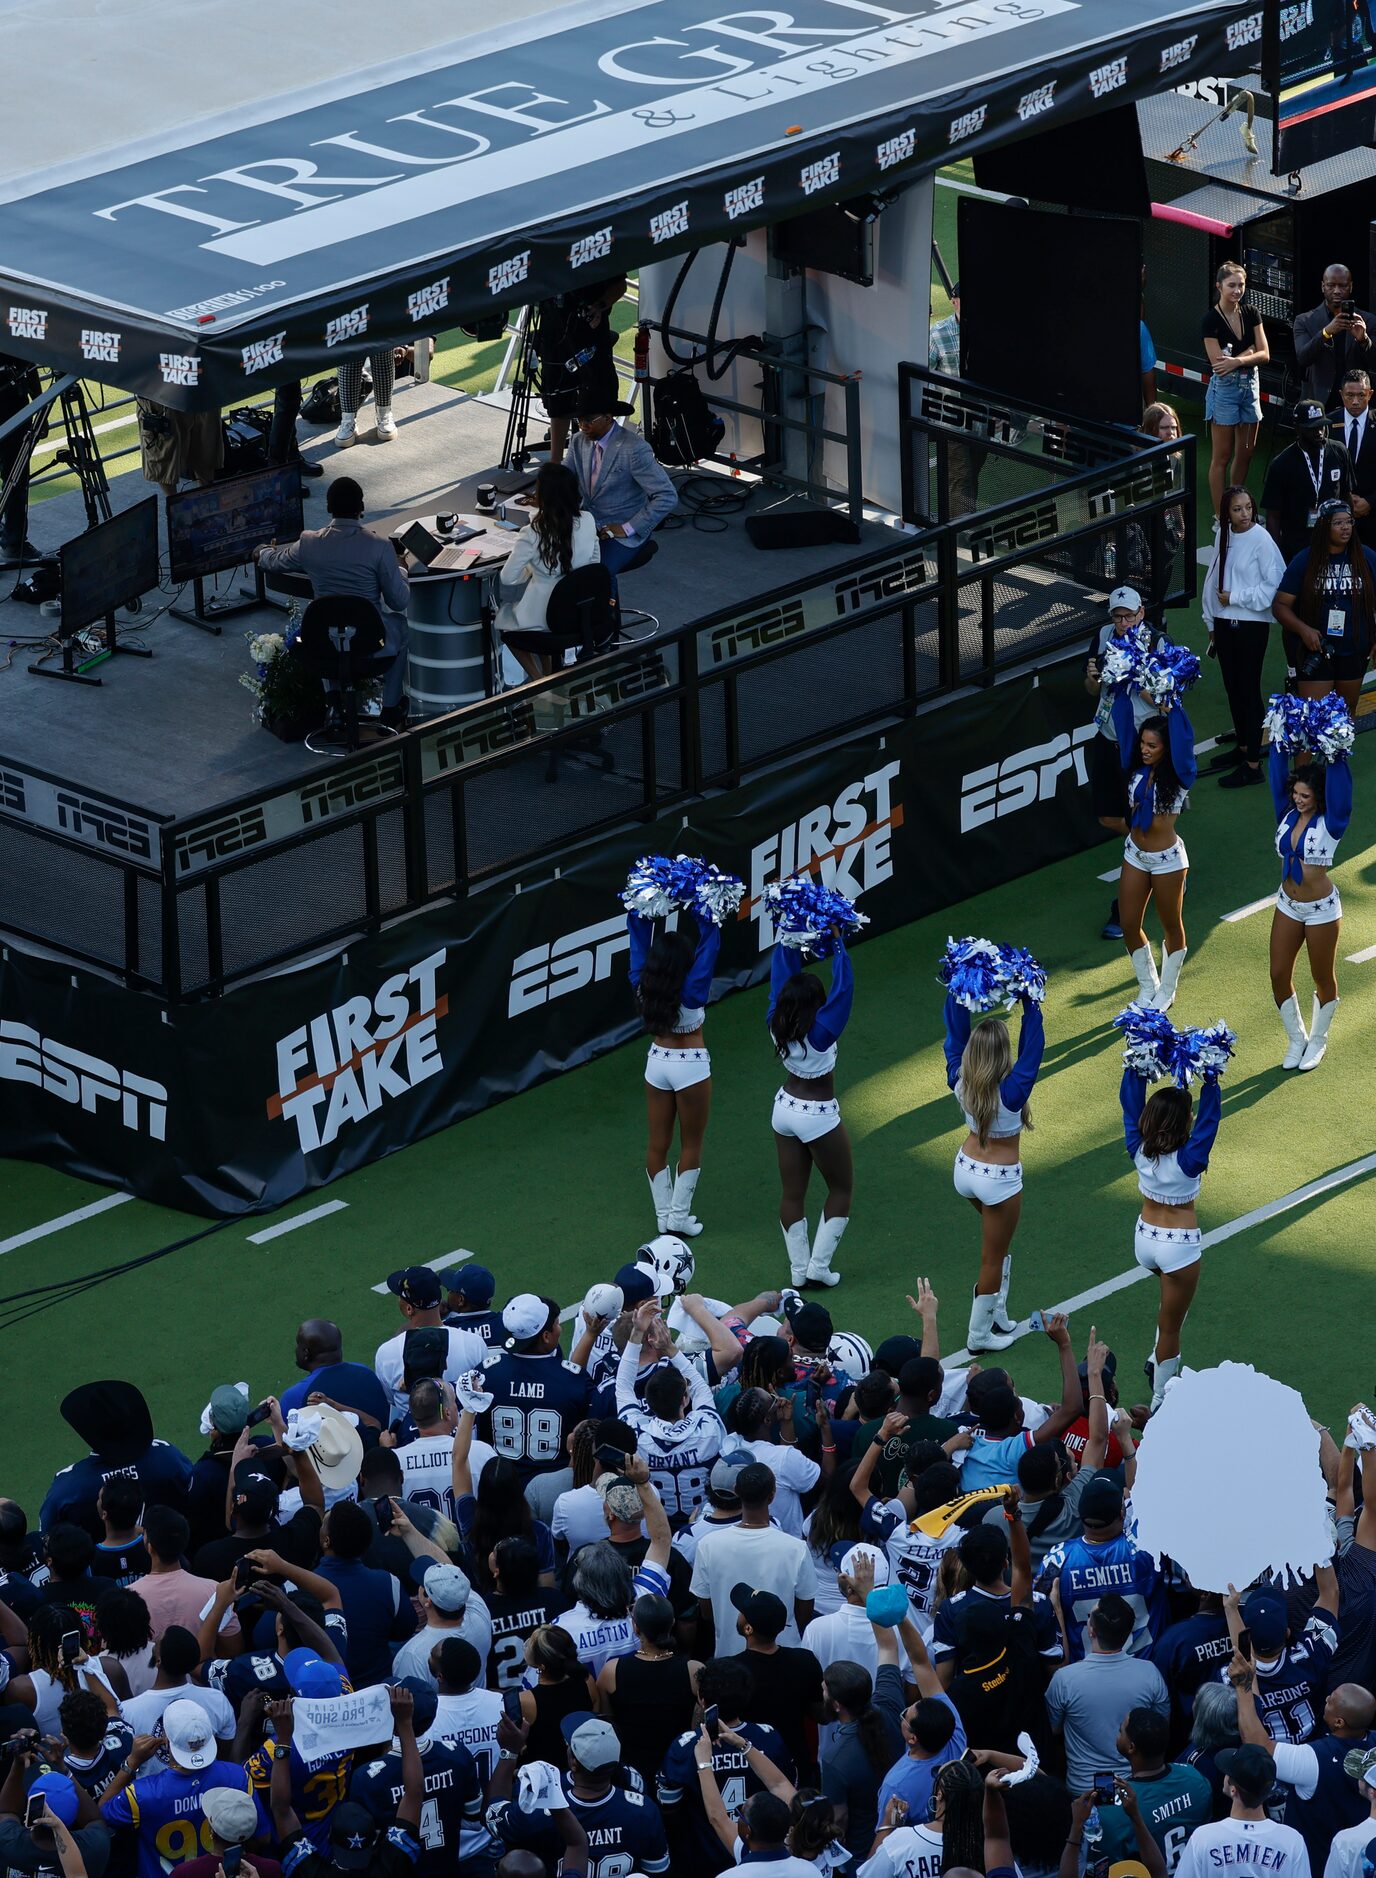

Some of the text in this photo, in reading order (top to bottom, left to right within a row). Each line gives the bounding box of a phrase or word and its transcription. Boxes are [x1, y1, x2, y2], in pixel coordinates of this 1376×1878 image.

[1226, 13, 1264, 43] FIRST
[1227, 28, 1263, 51] TAKE
[630, 2, 1048, 130] & Lighting
[1089, 57, 1128, 89] FIRST
[1090, 72, 1128, 99] TAKE
[93, 0, 952, 236] TRUE GRI
[876, 144, 915, 172] TAKE
[877, 129, 916, 160] FIRST
[801, 152, 841, 185] FIRST
[802, 168, 841, 196] TAKE
[724, 176, 765, 210] FIRST
[725, 193, 765, 221] TAKE
[649, 200, 688, 232] FIRST
[651, 216, 688, 245] TAKE
[570, 226, 612, 259] FIRST
[571, 241, 612, 269] TAKE
[489, 250, 531, 283] FIRST
[490, 266, 530, 295] TAKE
[408, 276, 450, 312] FIRST
[409, 293, 449, 323] TAKE
[9, 307, 48, 325] FIRST
[9, 322, 46, 340] TAKE
[326, 304, 370, 336] FIRST
[81, 329, 121, 348] FIRST
[241, 331, 286, 362] FIRST
[325, 319, 369, 347] TAKE
[82, 344, 119, 363] TAKE
[159, 353, 201, 372] FIRST
[243, 346, 285, 376] TAKE
[161, 368, 199, 386] TAKE
[922, 387, 1012, 446] ESPN
[751, 759, 900, 902] FIRST
[276, 948, 447, 1099] FIRST
[0, 1020, 168, 1142] ESPN
[282, 1014, 444, 1155] TAKE
[509, 1381, 545, 1400] LAMB
[491, 1405, 563, 1462] 88
[648, 1448, 700, 1470] BRYANT
[1070, 1563, 1132, 1590] E.SMITH
[491, 1607, 546, 1635] ELLIOTT
[579, 1622, 629, 1649] AUSTIN
[1258, 1681, 1311, 1710] ARSONS
[1260, 1697, 1317, 1745] 11
[418, 1797, 446, 1850] 4
[1151, 1792, 1193, 1825] SMITH
[1209, 1842, 1288, 1874] SEMIEN
